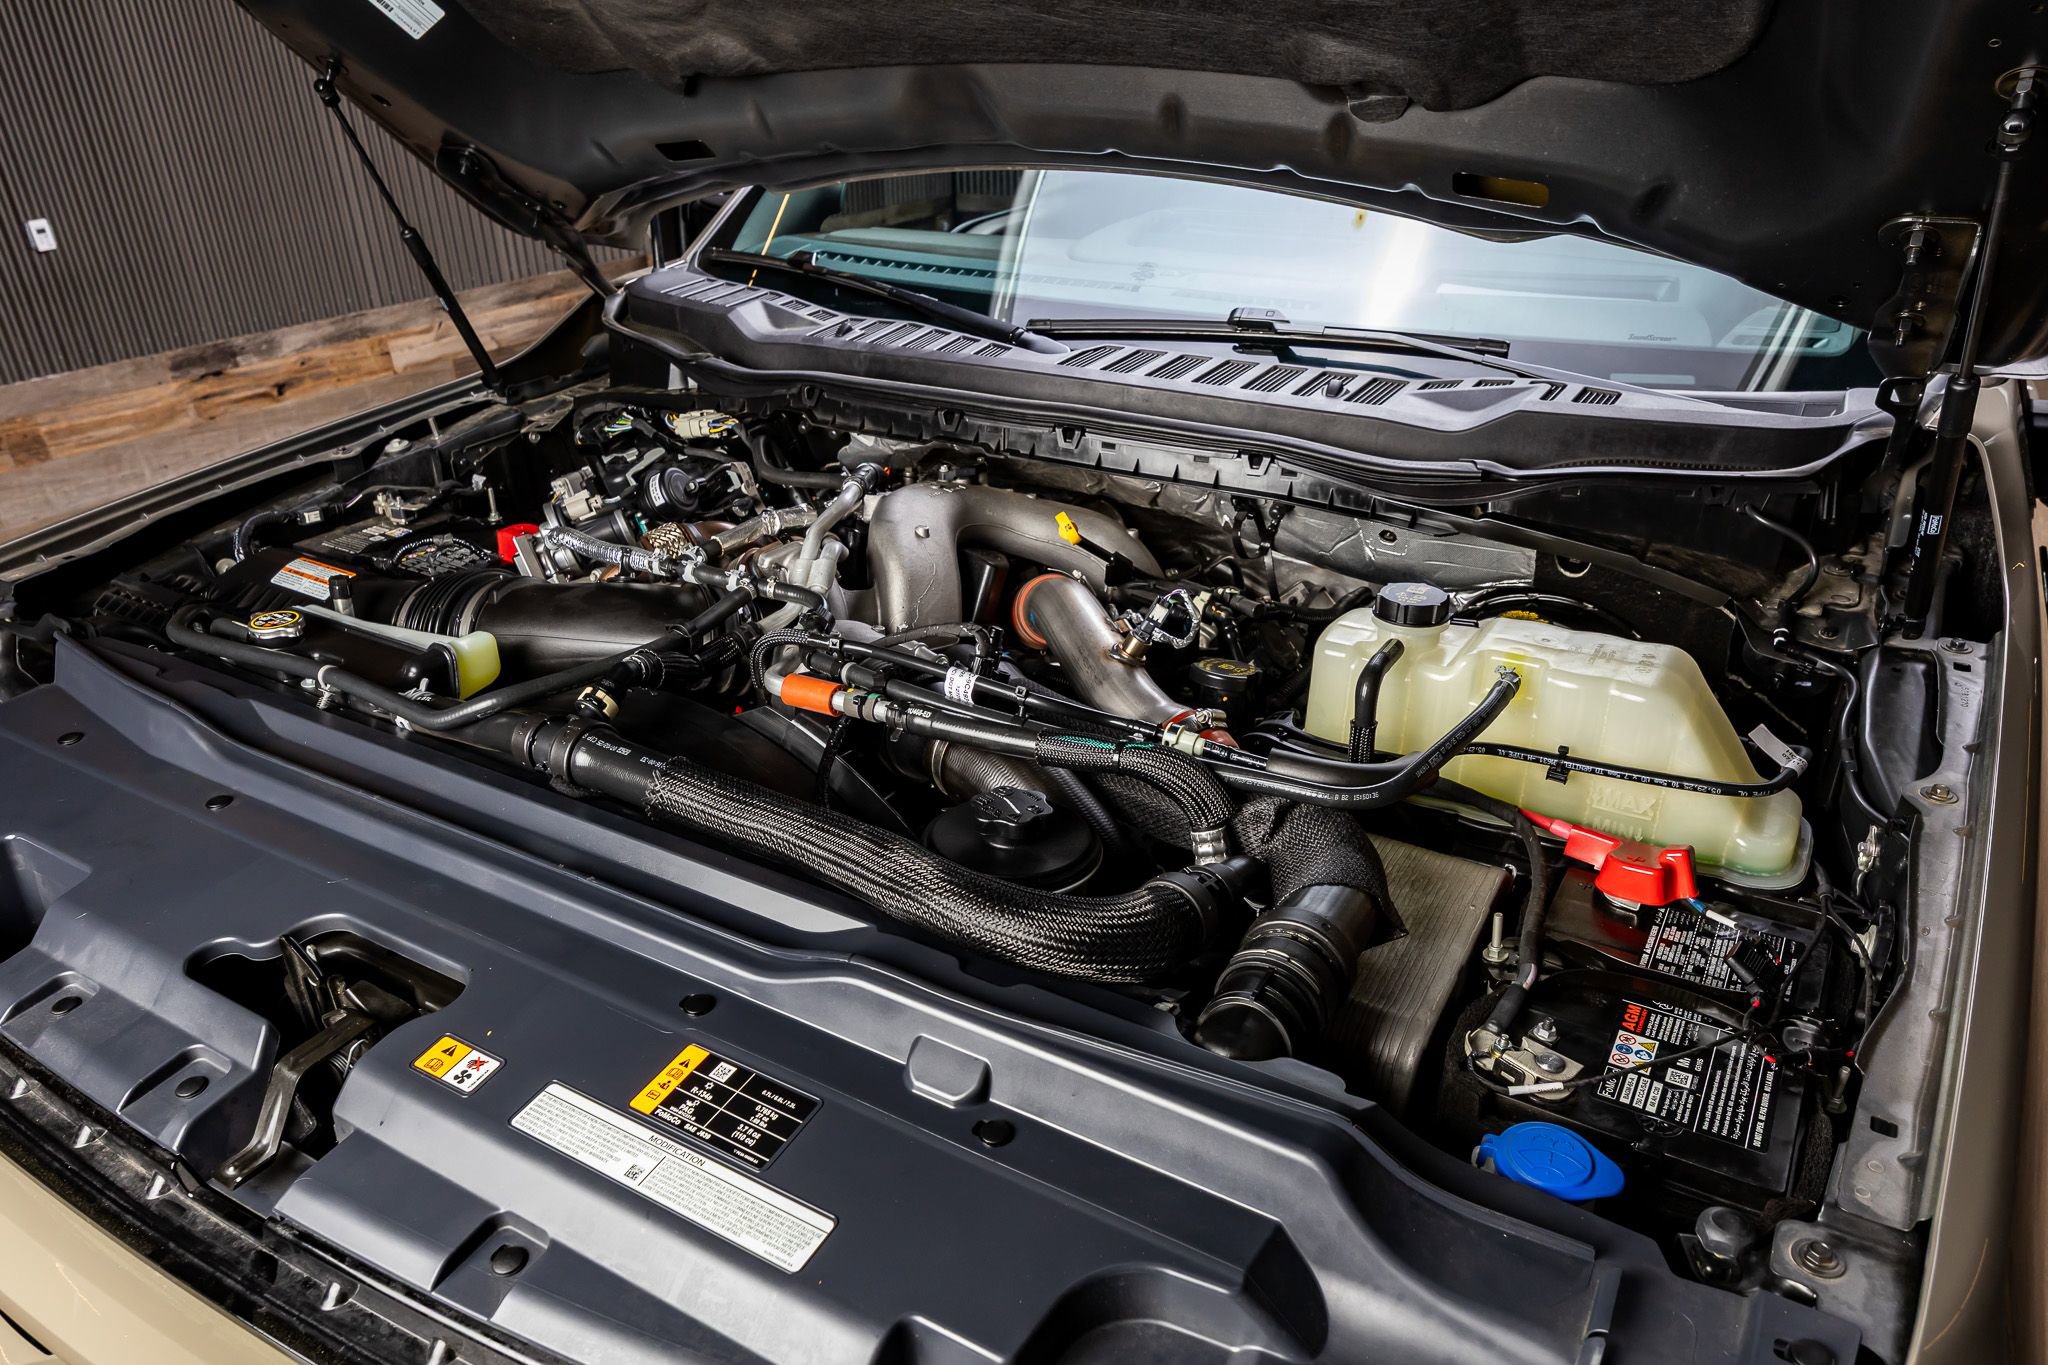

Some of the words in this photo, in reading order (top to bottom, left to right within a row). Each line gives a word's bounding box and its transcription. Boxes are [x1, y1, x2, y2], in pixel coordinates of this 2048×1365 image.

[1603, 789, 1657, 816] MAX
[1622, 1004, 1642, 1031] AGM
[1636, 1009, 1647, 1032] TECHNOLOGY
[690, 1086, 713, 1100] R-134a
[678, 1105, 694, 1114] PAG
[767, 1111, 778, 1120] kg
[654, 1108, 681, 1125] FoMoCo
[684, 1123, 697, 1133] SAE
[696, 1130, 711, 1139] J639
[737, 1123, 749, 1132] 3.7
[648, 1135, 706, 1166] MODIFICATION
